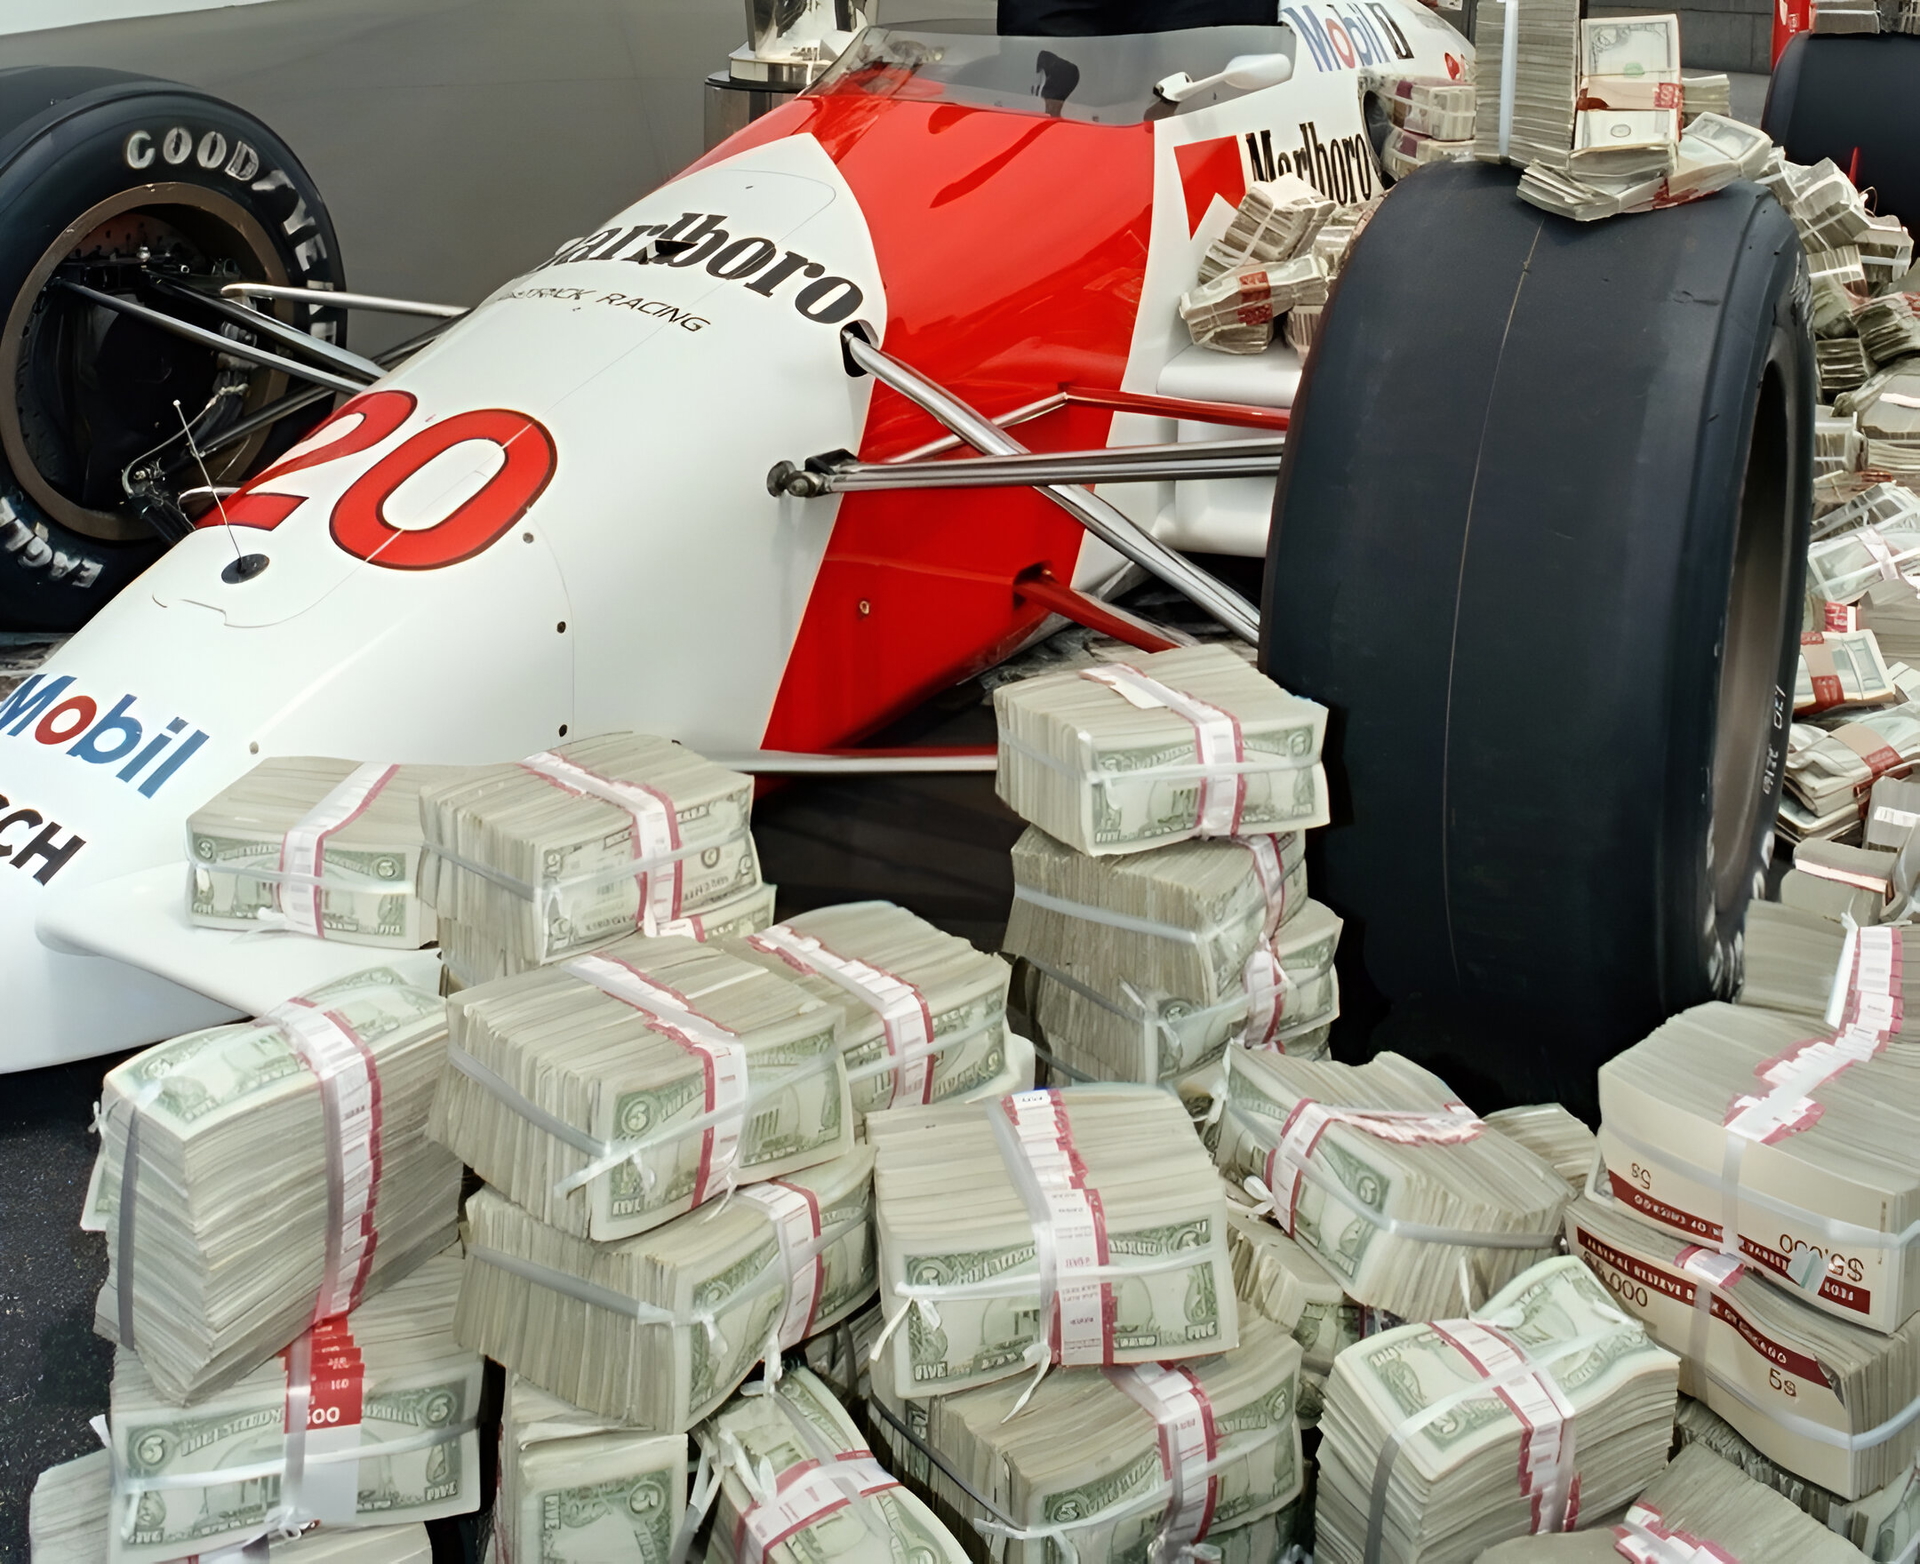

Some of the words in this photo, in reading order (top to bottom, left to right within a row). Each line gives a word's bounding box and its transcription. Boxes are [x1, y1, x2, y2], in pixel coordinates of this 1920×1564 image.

[1282, 3, 1390, 72] Mobil
[1245, 121, 1371, 206] Marlboro
[533, 212, 863, 324] arlboro
[597, 293, 710, 331] RACING
[194, 390, 557, 571] 20
[0, 674, 210, 799] Mobil
[0, 794, 87, 886] CH
